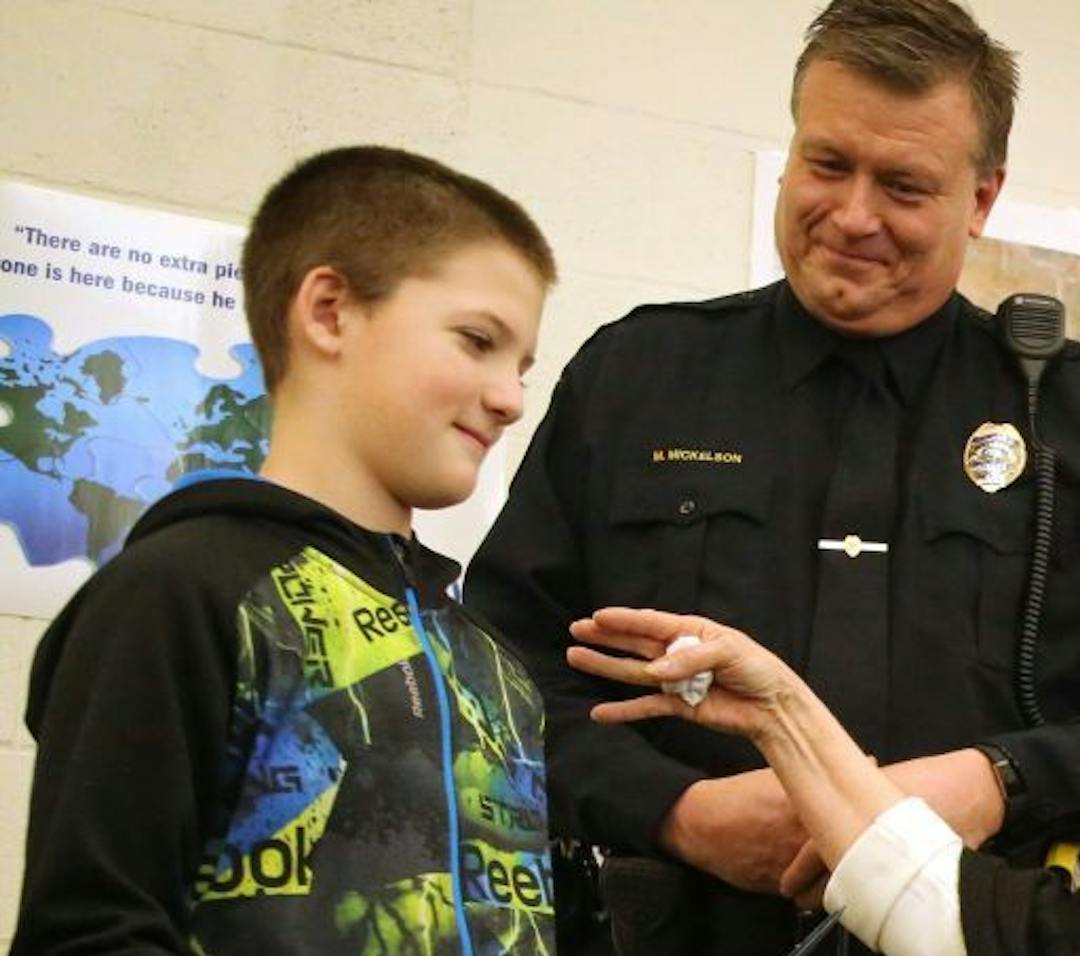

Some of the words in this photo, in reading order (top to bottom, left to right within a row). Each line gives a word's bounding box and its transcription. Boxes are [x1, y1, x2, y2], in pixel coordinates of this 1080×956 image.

[88, 241, 121, 259] are
[128, 248, 153, 265] no
[159, 254, 208, 275] extra
[0, 258, 38, 277] one
[45, 262, 63, 281] is
[69, 266, 115, 290] here
[121, 275, 206, 305] because
[211, 290, 236, 309] he
